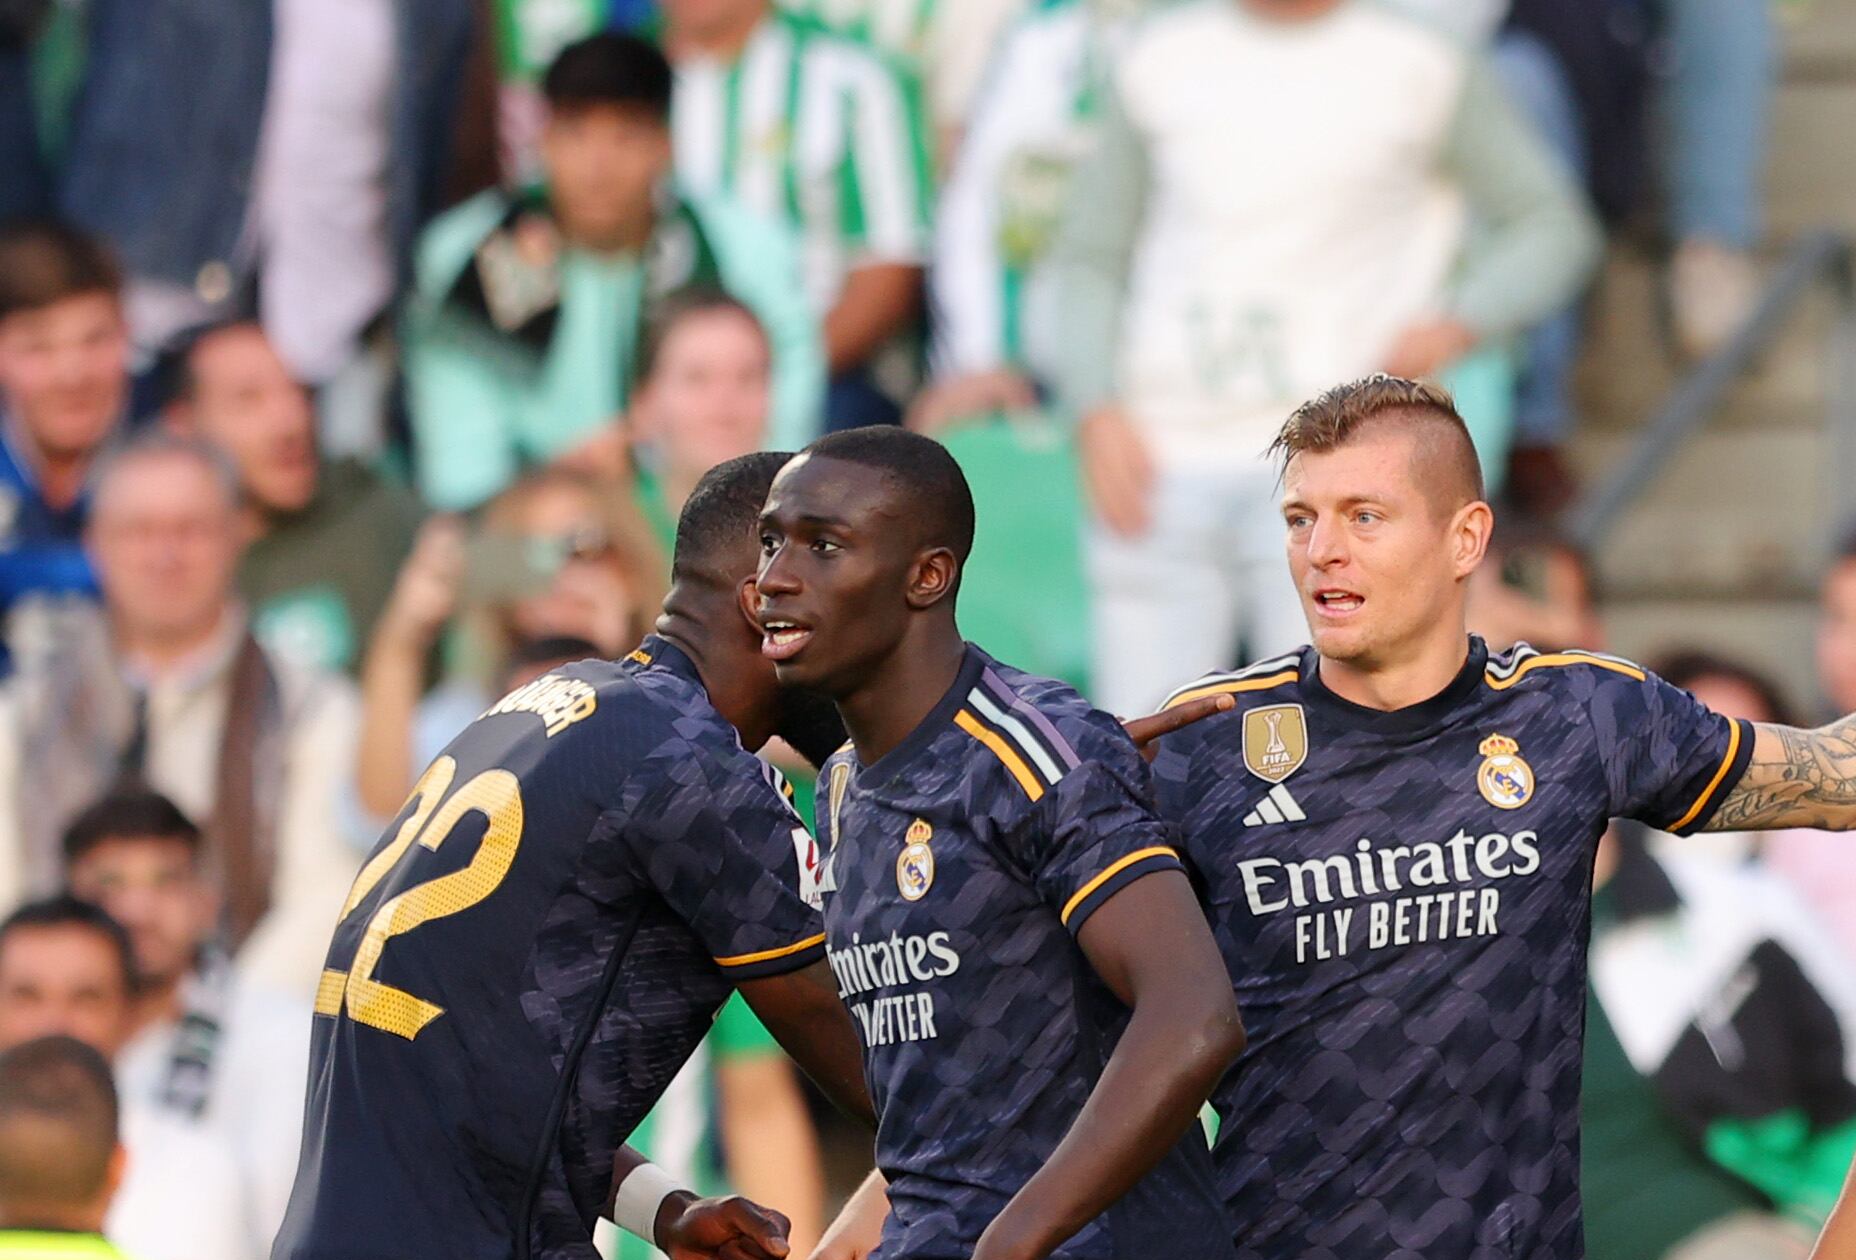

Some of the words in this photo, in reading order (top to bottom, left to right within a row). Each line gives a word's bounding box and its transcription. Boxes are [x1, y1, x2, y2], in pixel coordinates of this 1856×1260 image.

[1262, 752, 1291, 766] FIFA
[313, 754, 525, 1042] 22
[1236, 828, 1541, 916] Emirates
[1296, 908, 1353, 963] FLY
[1369, 887, 1500, 949] BETTER
[868, 992, 938, 1047] ETTER
